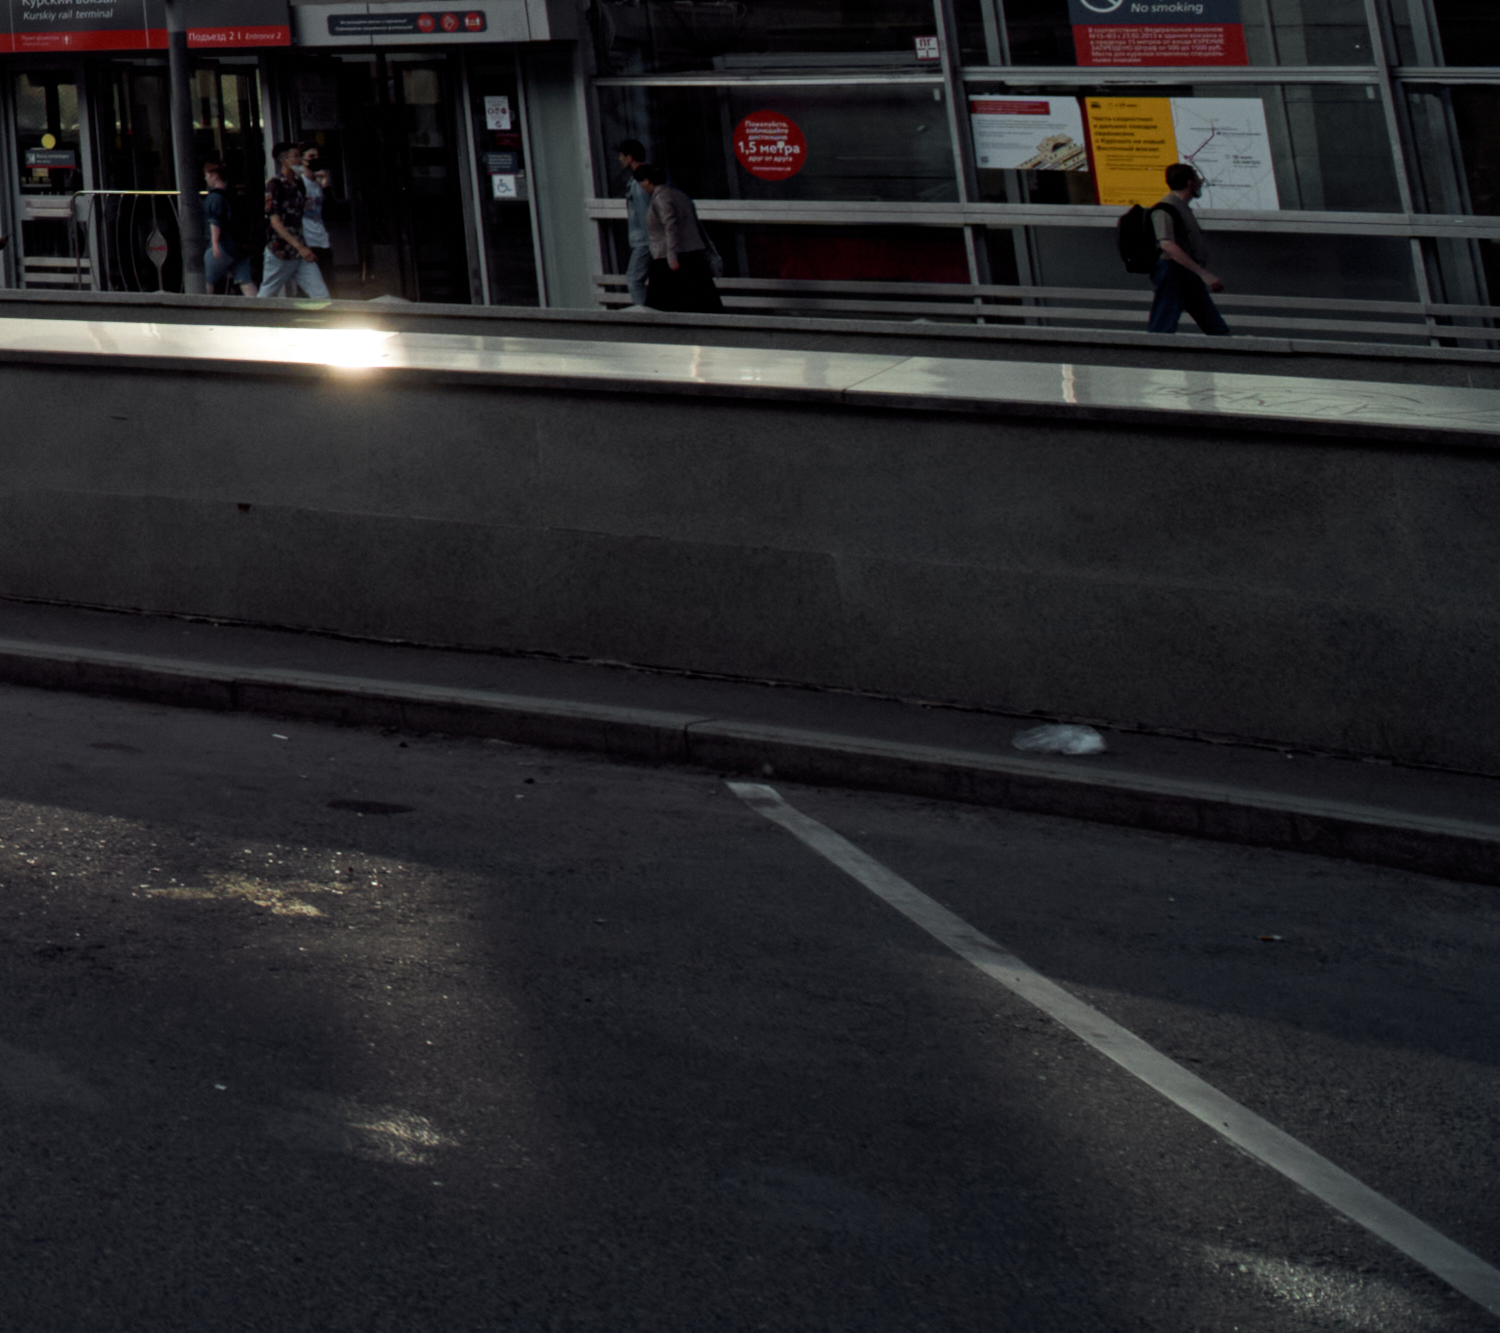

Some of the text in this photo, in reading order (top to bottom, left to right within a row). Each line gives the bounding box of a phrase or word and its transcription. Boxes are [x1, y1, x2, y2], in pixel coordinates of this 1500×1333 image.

[1131, 2, 1204, 14] No smoking
[23, 8, 114, 23] Kurskiy rail terminal
[229, 31, 235, 41] 2
[738, 141, 801, 156] 1,5 метра
